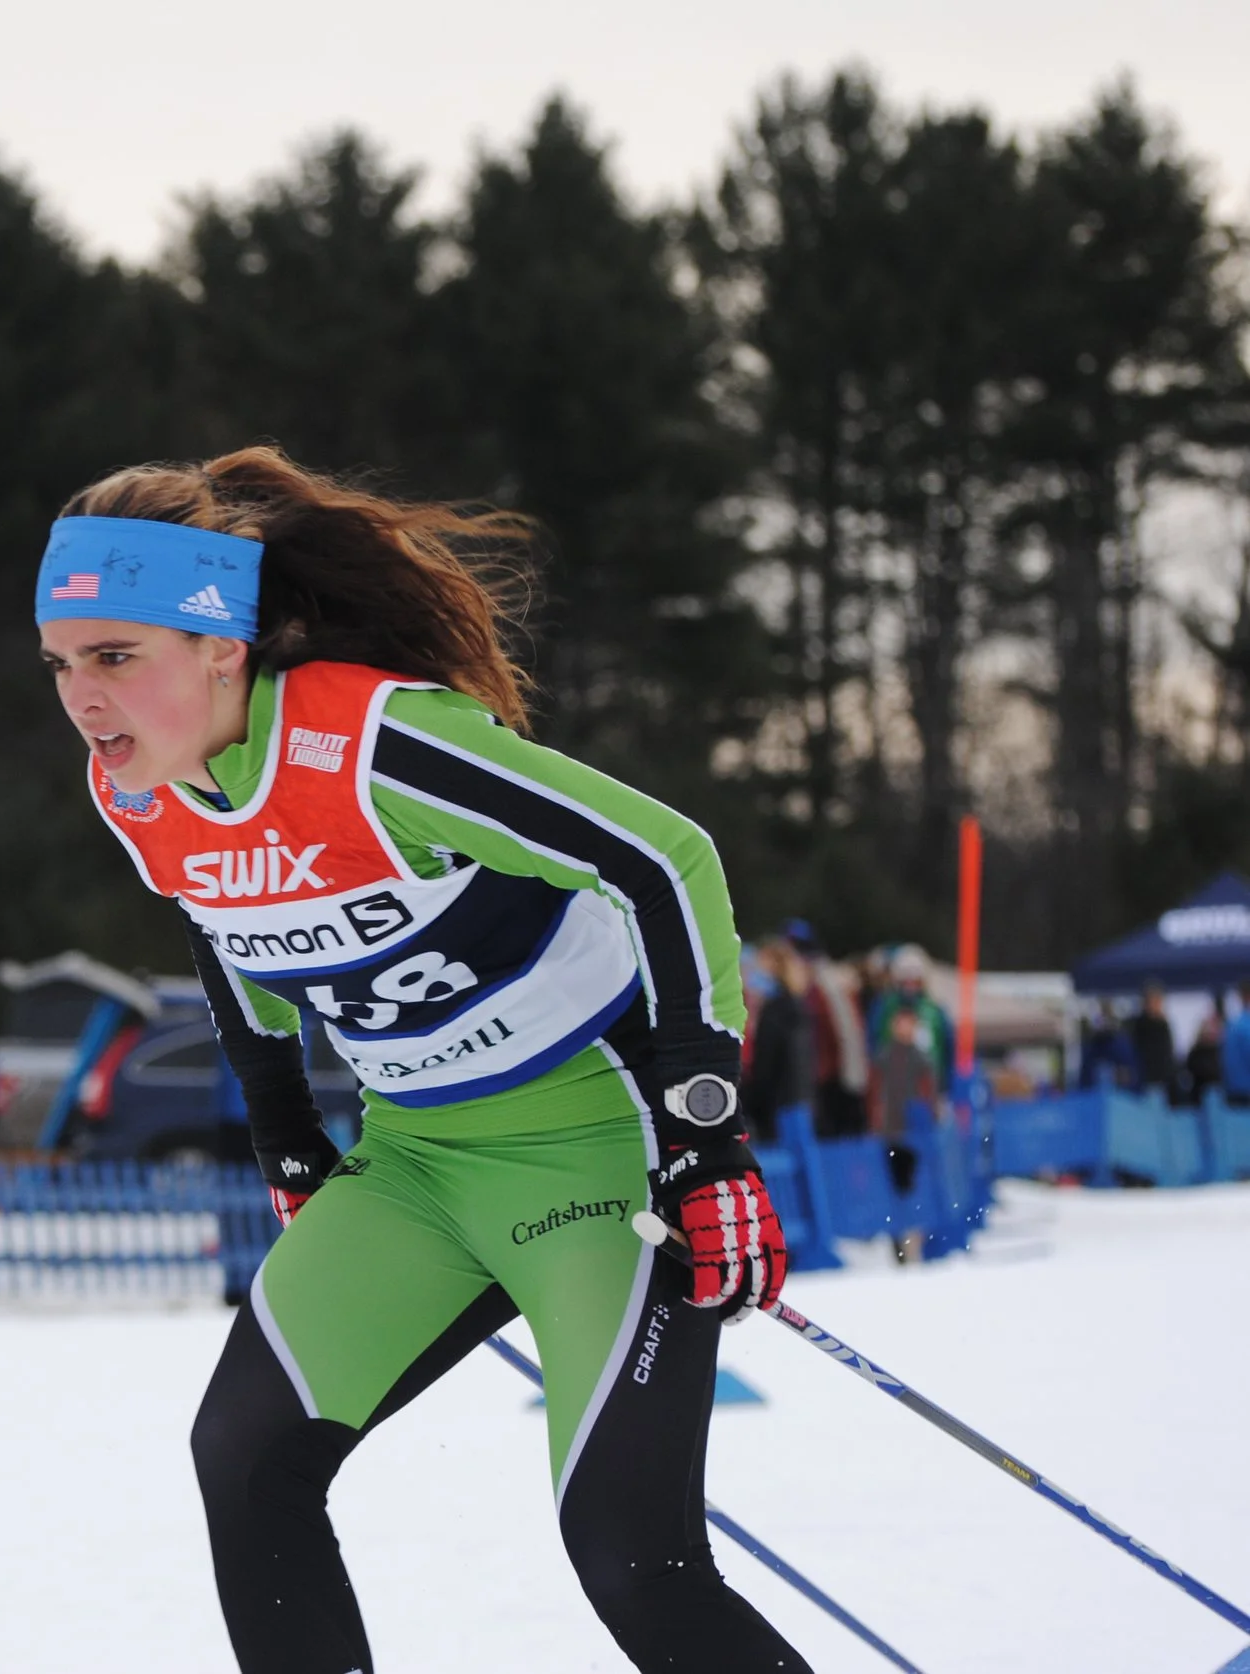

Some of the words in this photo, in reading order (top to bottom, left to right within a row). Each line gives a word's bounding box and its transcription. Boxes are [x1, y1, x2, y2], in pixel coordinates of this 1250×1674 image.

[178, 603, 233, 620] adidas
[511, 1199, 631, 1246] Craftsbury
[633, 1316, 665, 1385] CRAFT
